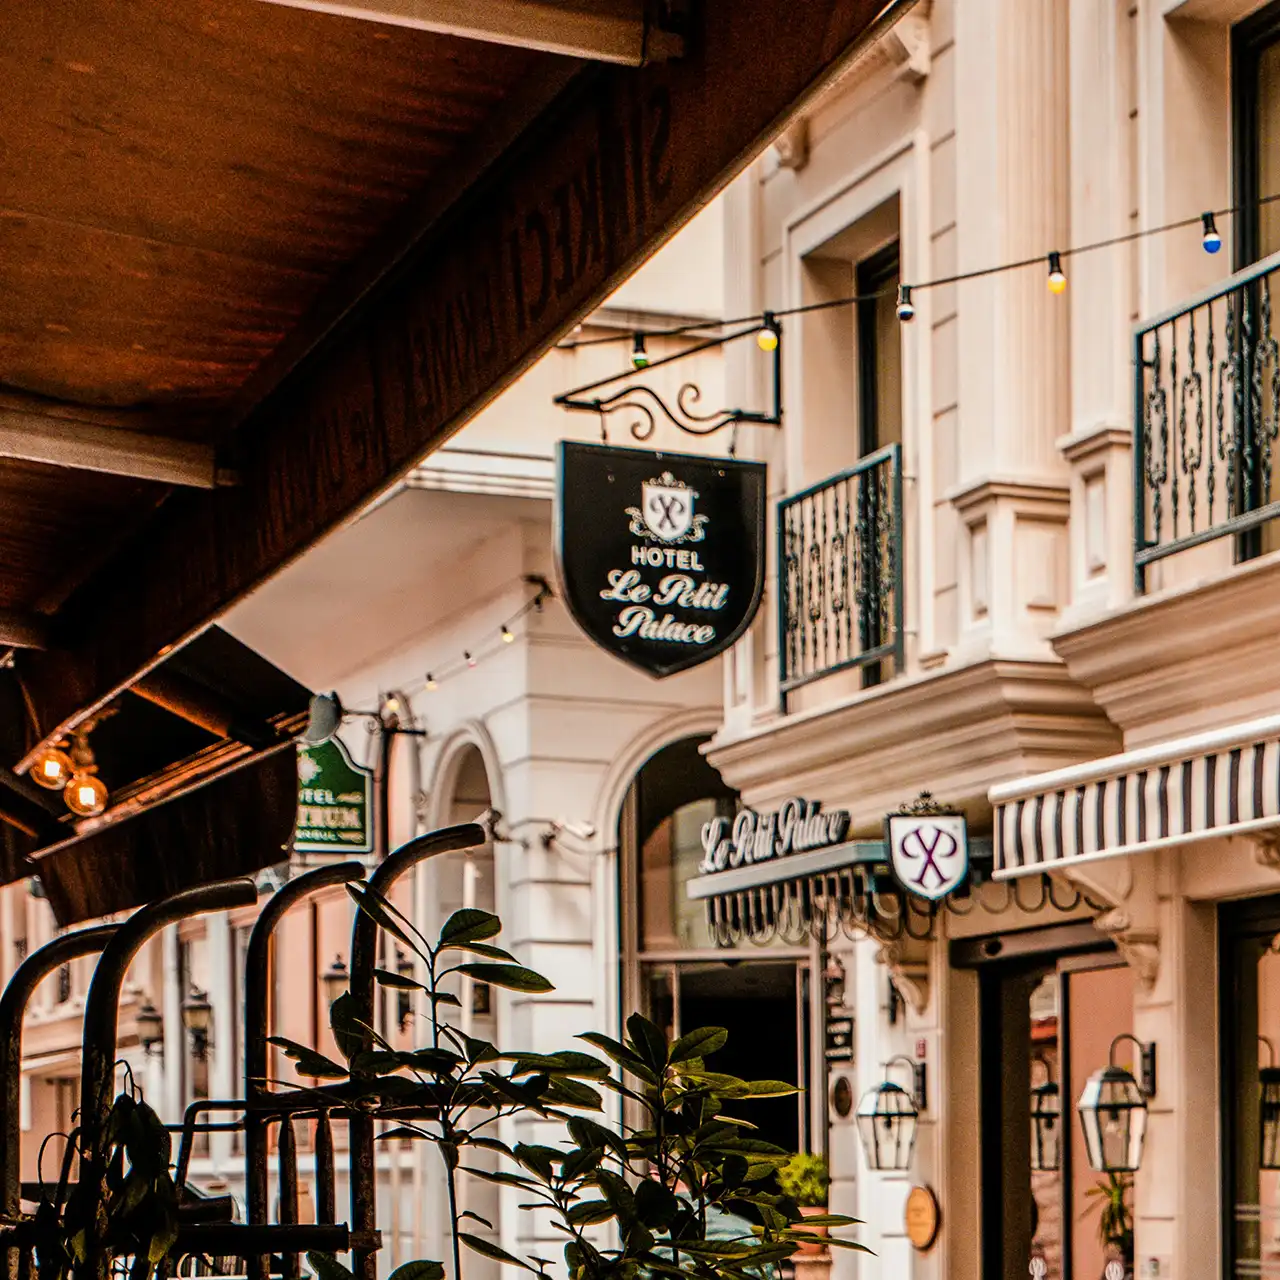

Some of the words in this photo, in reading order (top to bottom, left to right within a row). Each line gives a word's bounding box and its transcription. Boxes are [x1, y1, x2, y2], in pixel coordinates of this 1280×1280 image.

[631, 545, 705, 571] HOTEL
[600, 569, 652, 603] Le
[653, 574, 730, 610] Petit
[612, 605, 717, 644] Palace
[698, 817, 731, 874] Le
